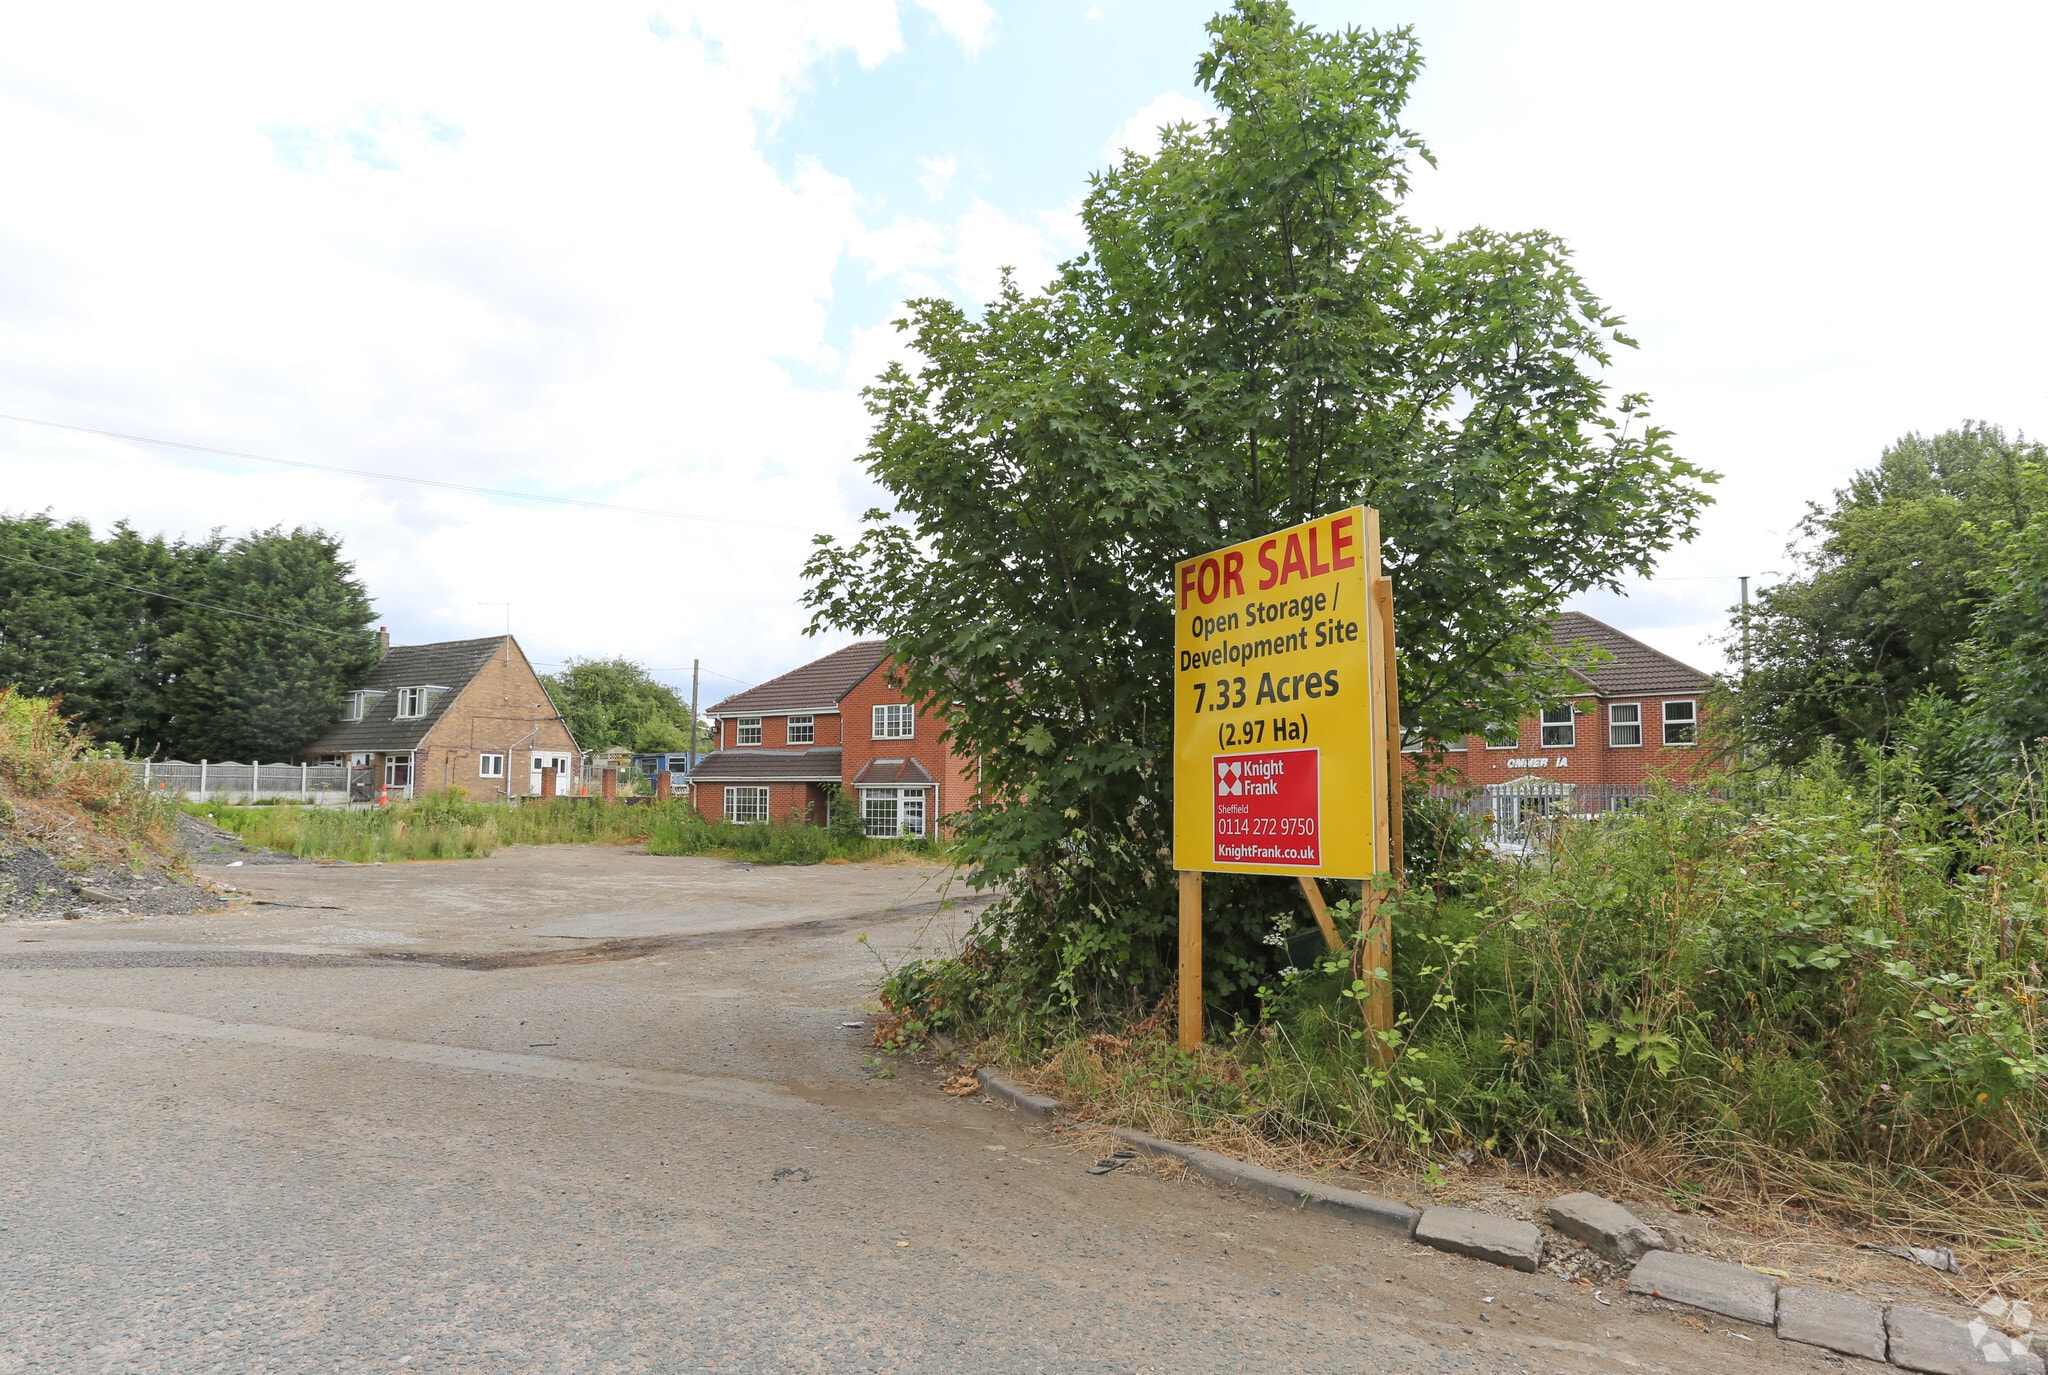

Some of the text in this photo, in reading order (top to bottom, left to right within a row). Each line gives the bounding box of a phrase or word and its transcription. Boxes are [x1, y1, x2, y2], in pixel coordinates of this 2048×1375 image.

[1182, 516, 1355, 610] FOR SALE
[1192, 582, 1340, 641] Open Storage /
[1181, 618, 1359, 671] Development Site
[1193, 670, 1340, 714] 7.33 Acres
[1218, 714, 1308, 750] (2.97 Ha)
[1244, 760, 1284, 779] Knight
[1244, 779, 1278, 795] Frank
[1218, 804, 1249, 814] Sheffield
[1218, 817, 1315, 836] 0114 272 9750
[1218, 844, 1315, 860] KnightFrank.co.uk
